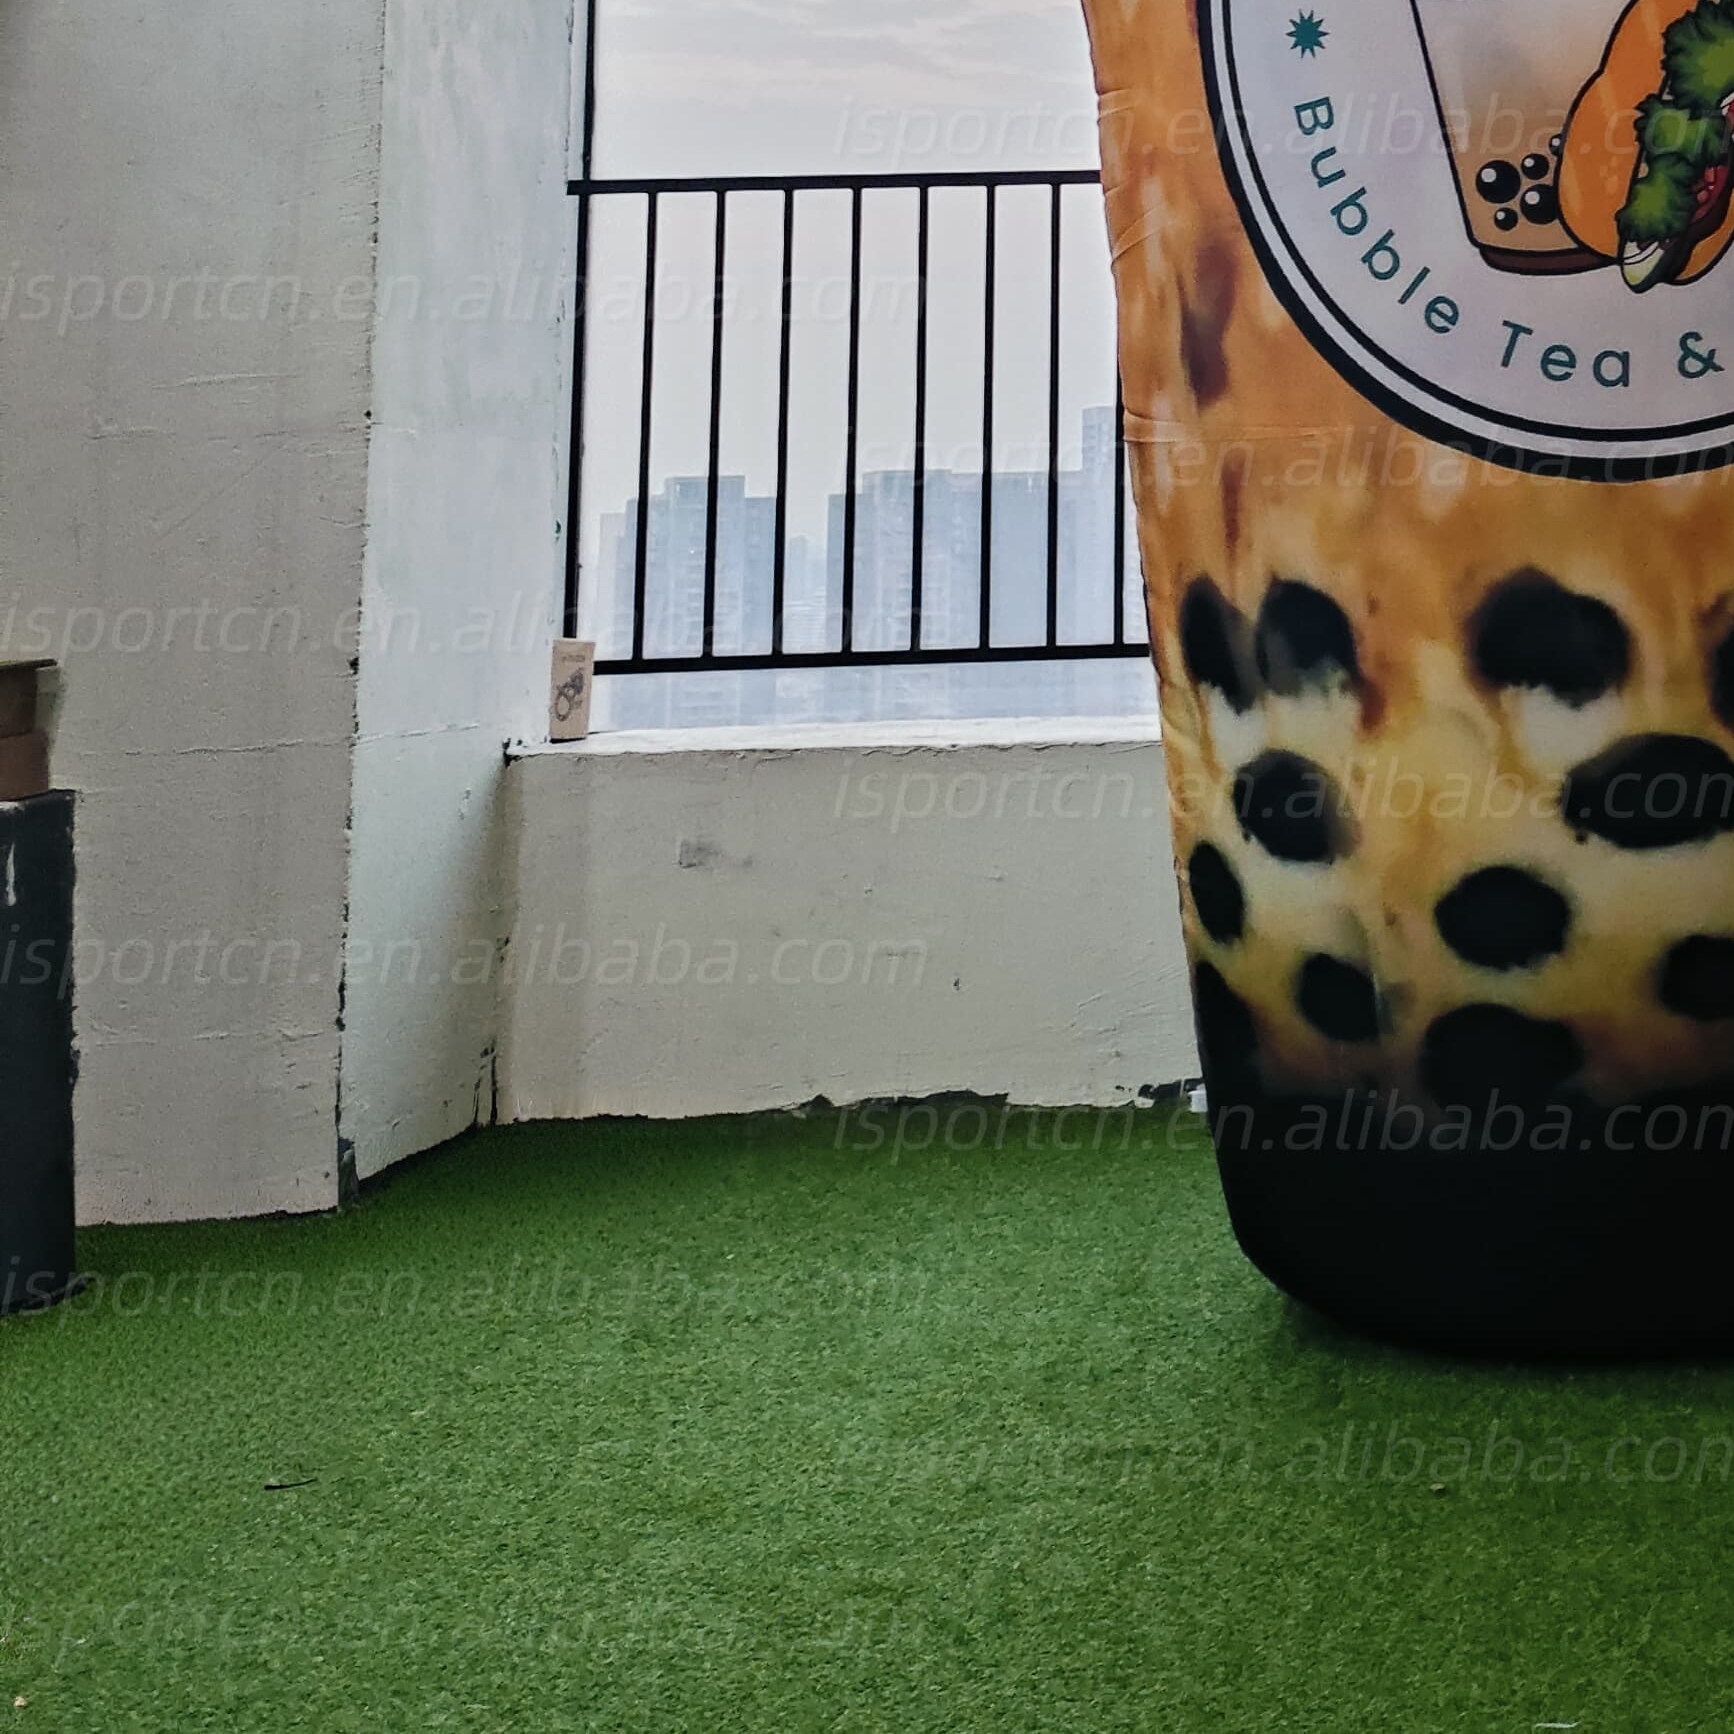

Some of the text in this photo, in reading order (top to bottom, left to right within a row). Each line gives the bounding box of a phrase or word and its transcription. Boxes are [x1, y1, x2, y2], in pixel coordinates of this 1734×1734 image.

[1293, 97, 1461, 335] Bubble
[1500, 321, 1631, 389] Tea
[1676, 332, 1725, 380] &
